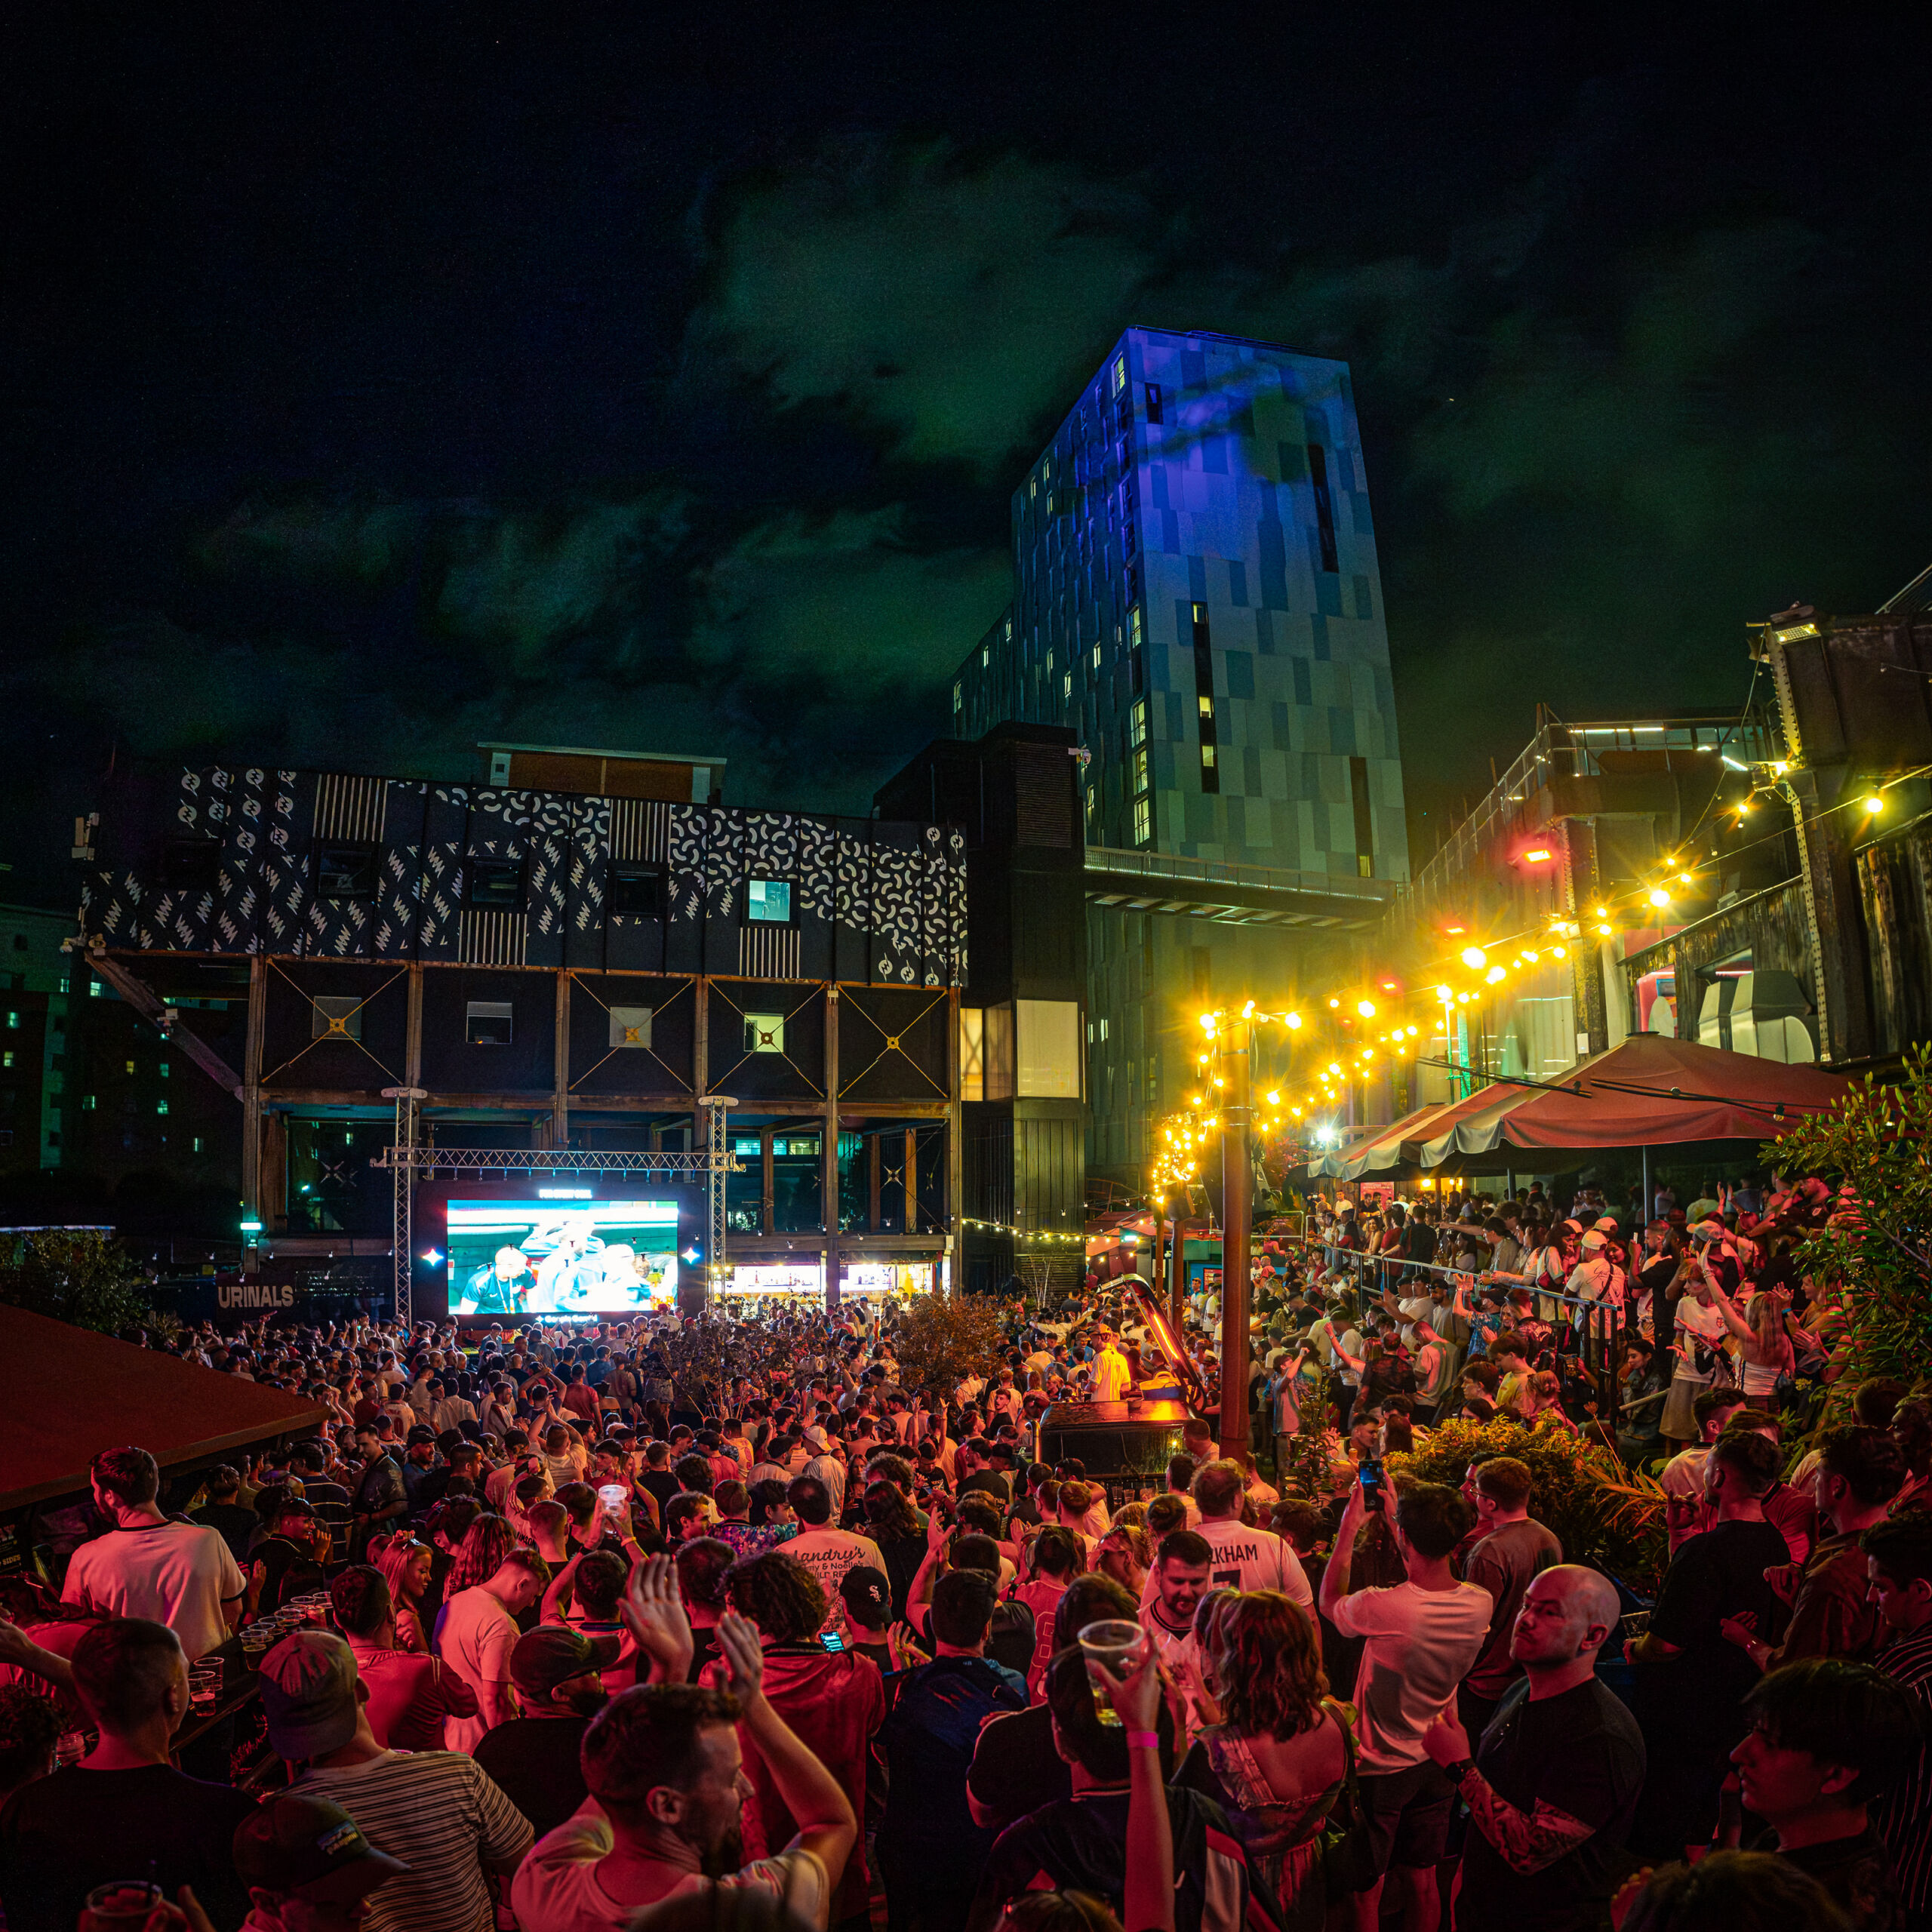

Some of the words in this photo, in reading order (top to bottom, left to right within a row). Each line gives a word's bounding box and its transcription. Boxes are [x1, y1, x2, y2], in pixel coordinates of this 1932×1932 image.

[217, 1285, 294, 1309] URINALS
[1211, 1545, 1258, 1564] KHAM
[1213, 1569, 1241, 1589] 7
